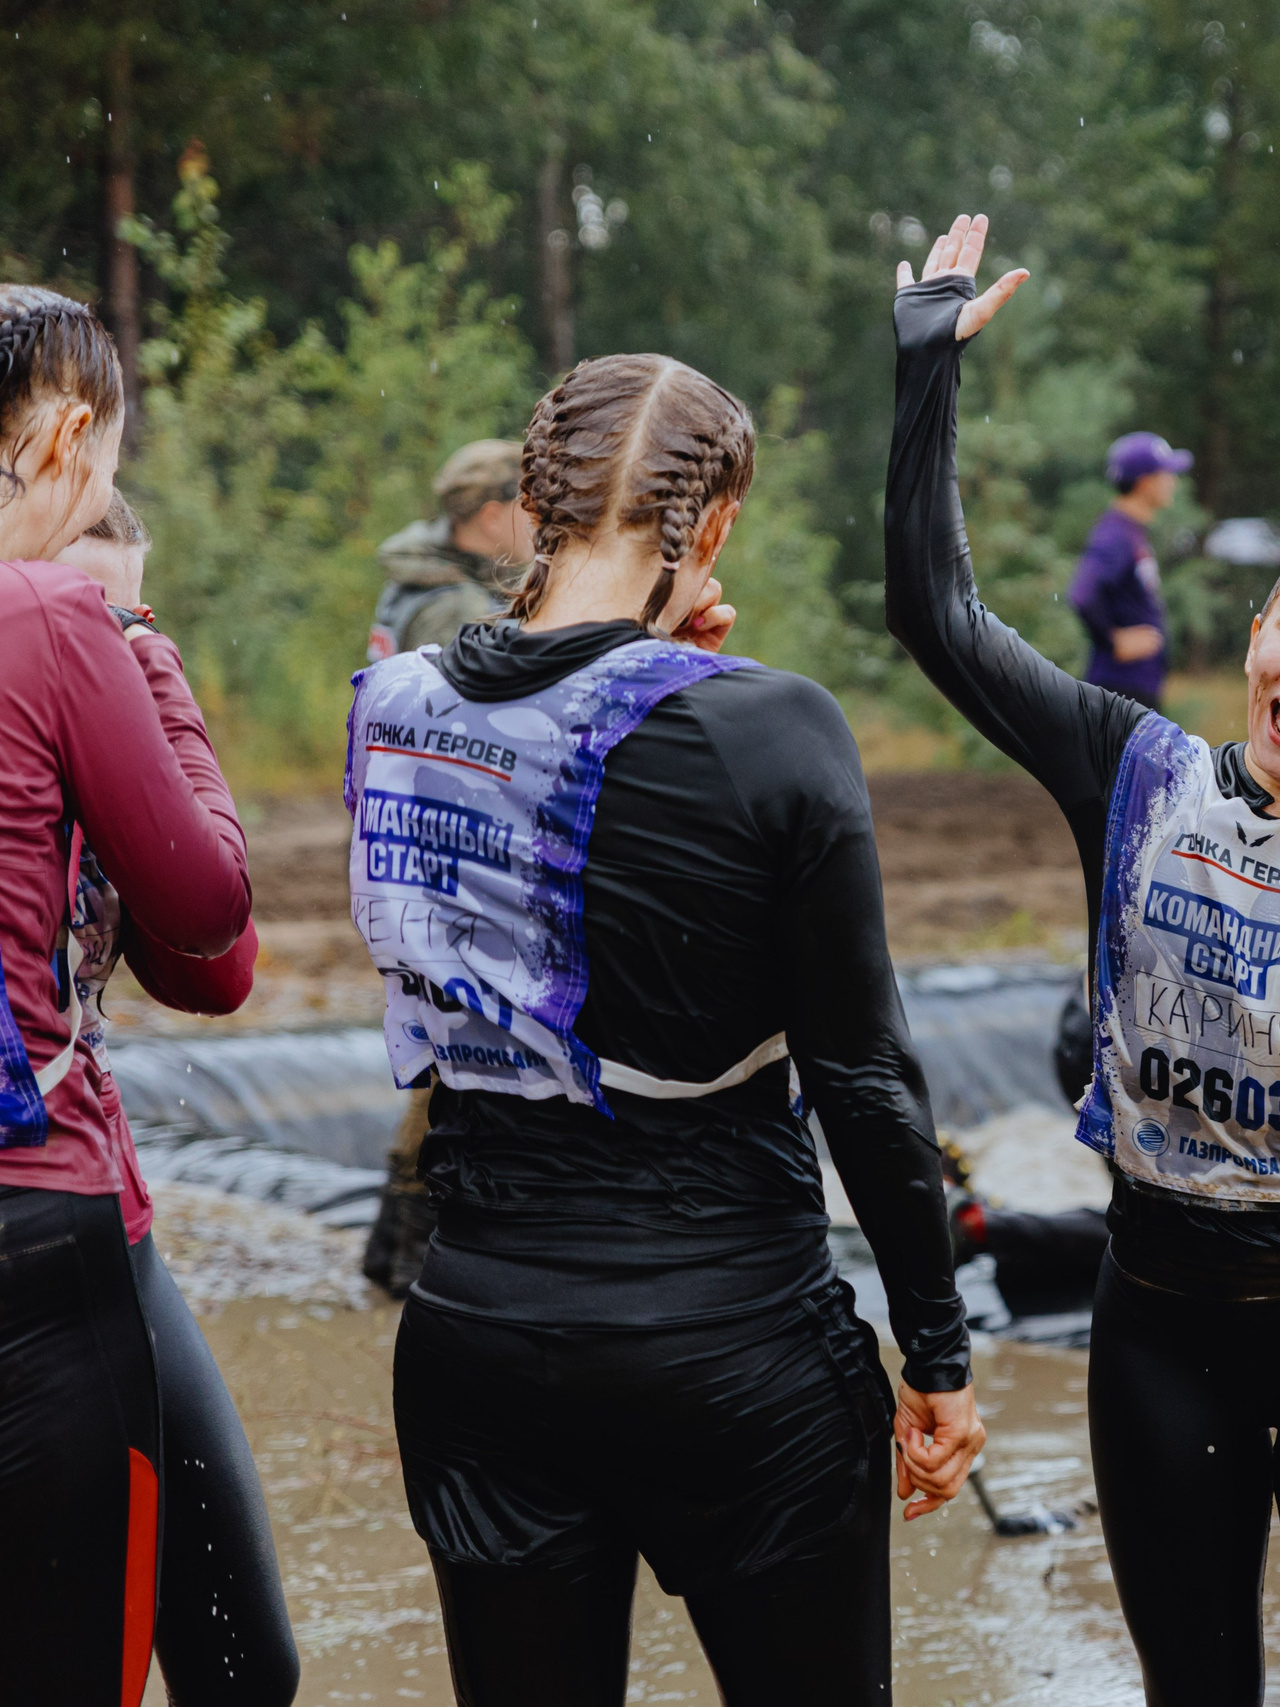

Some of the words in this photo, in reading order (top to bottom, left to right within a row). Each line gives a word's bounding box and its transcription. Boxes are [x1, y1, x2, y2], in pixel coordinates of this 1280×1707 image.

[366, 722, 416, 748] ГОНКА
[423, 729, 518, 772] ГЕРОЕВ
[362, 796, 508, 864] МАНДНЫЙ
[1174, 832, 1232, 869] ГОНКА
[369, 841, 453, 890] СТАРТ
[1190, 942, 1264, 995] СТАРТ
